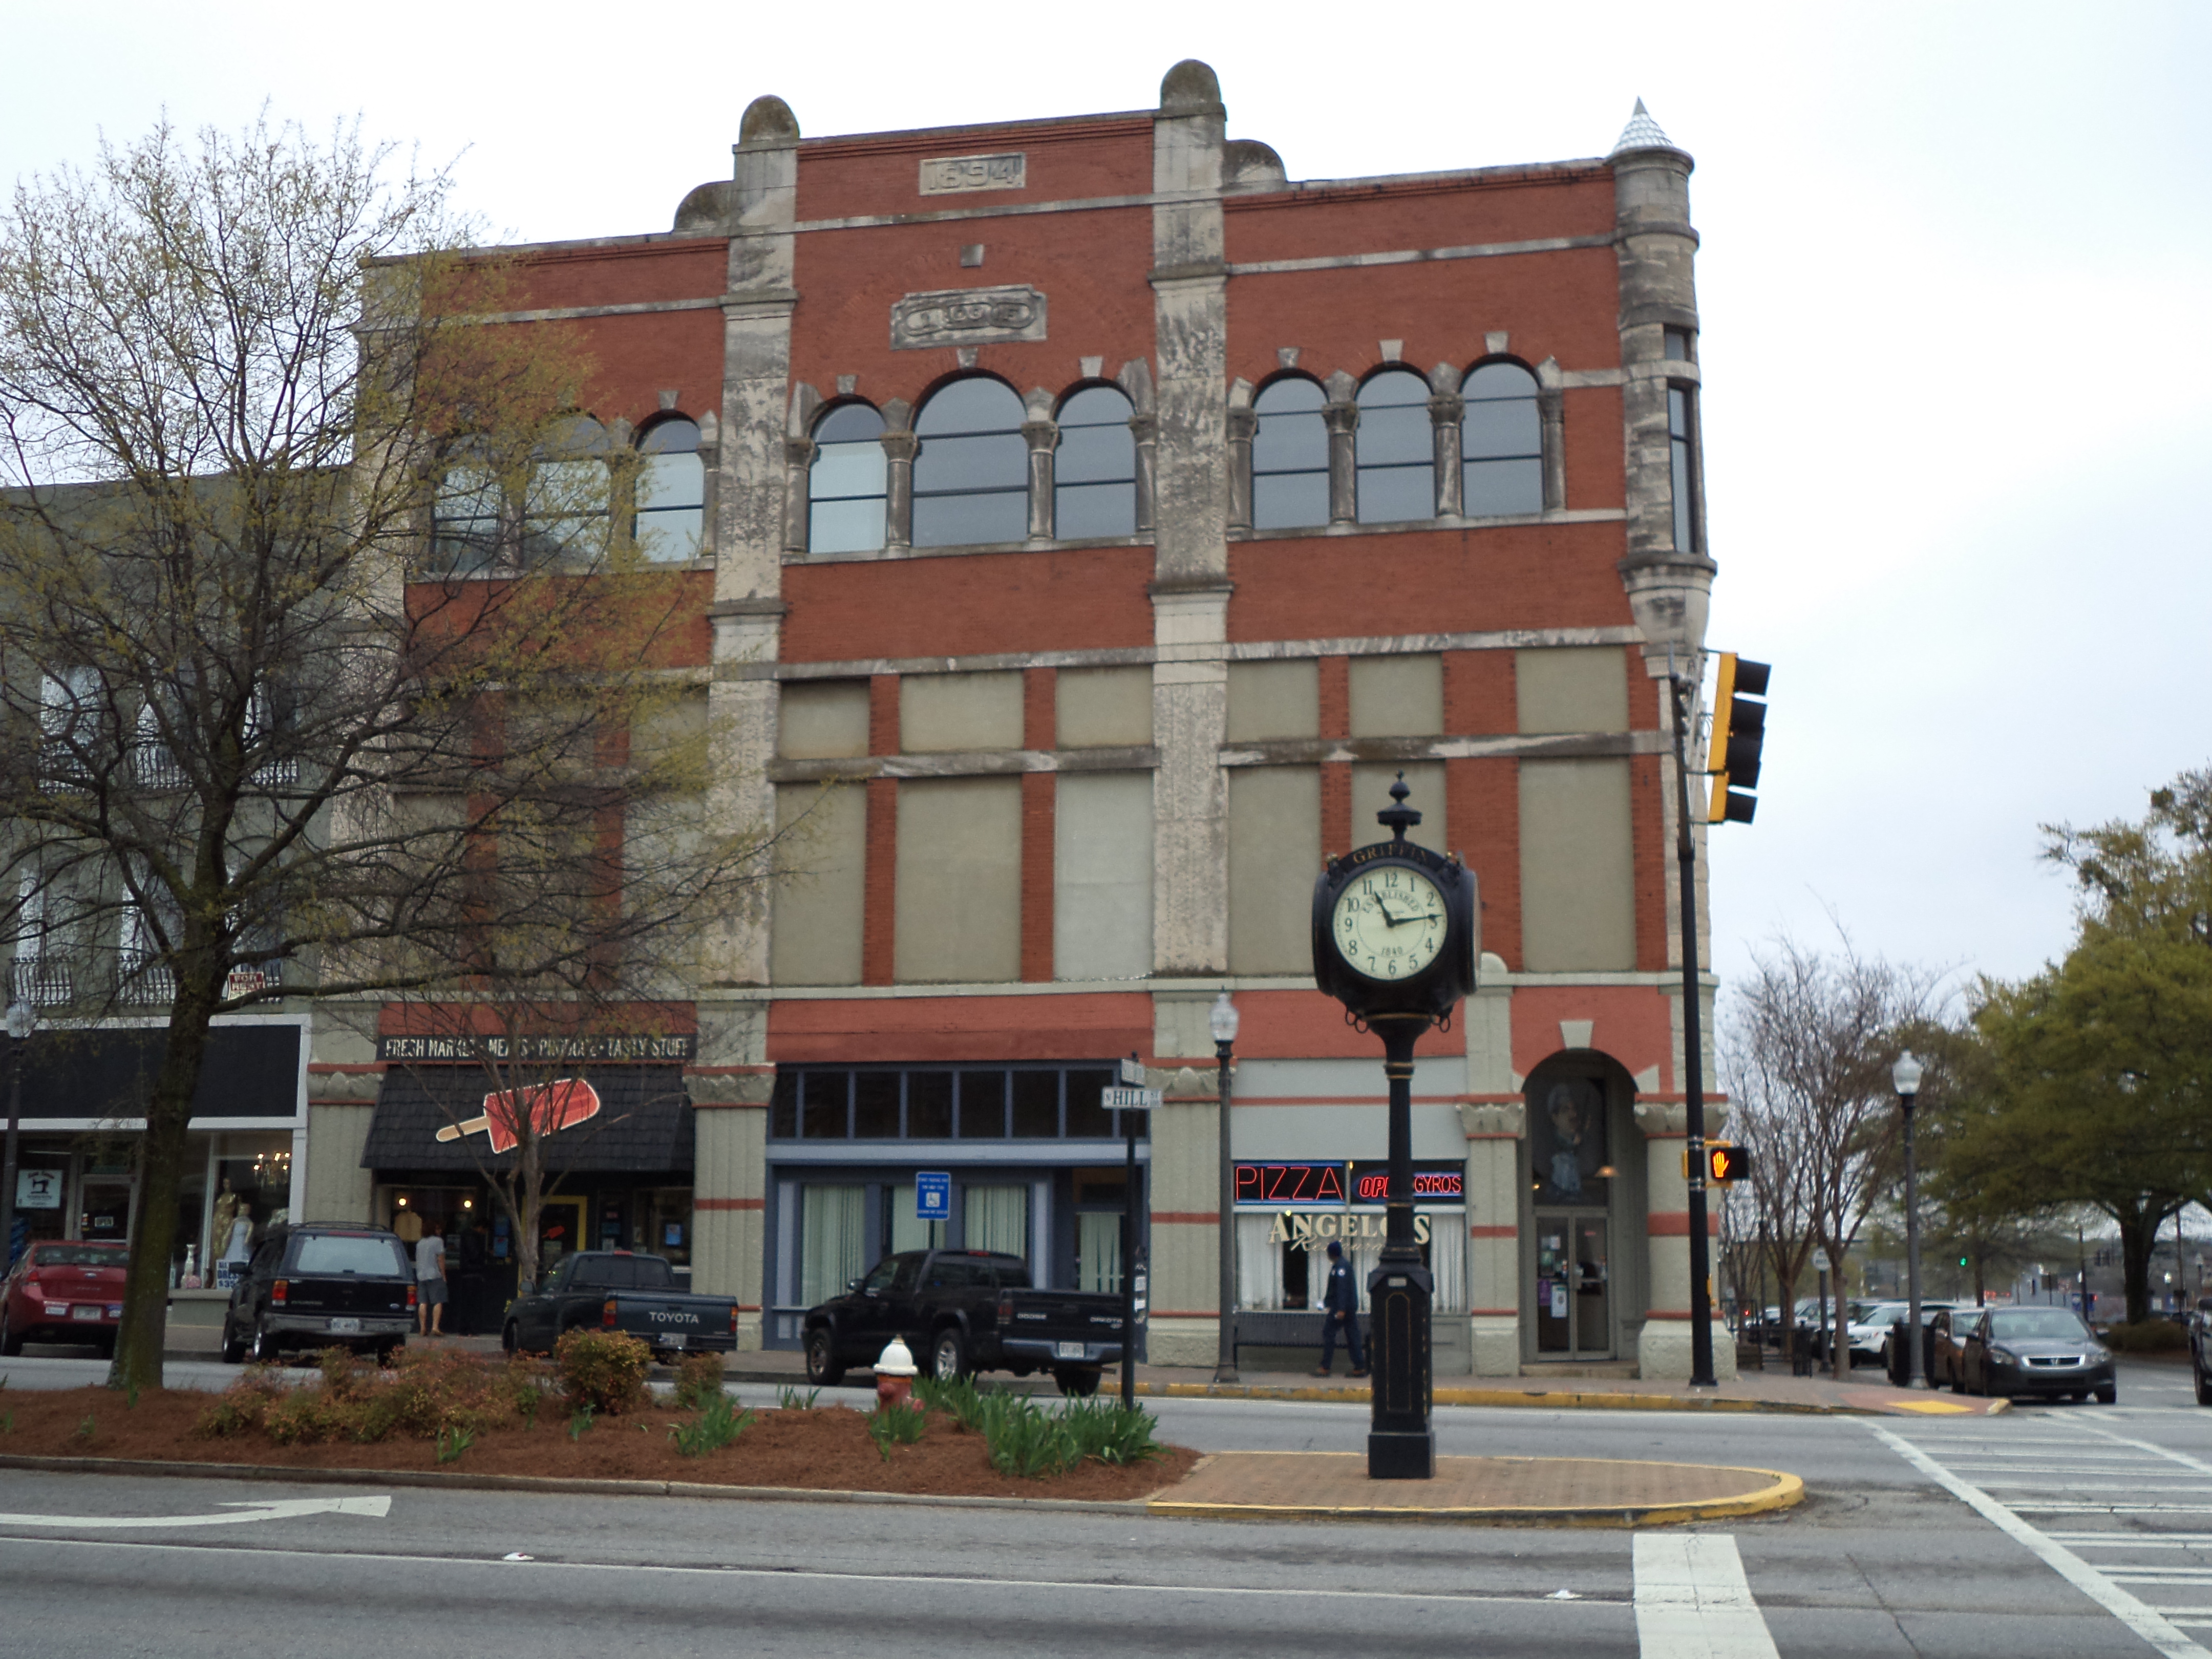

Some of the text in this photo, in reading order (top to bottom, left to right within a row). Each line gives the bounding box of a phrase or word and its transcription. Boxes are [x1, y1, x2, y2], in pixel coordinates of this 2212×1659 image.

[928, 160, 1014, 190] 1894
[1386, 870, 1398, 887] 12
[1410, 877, 1415, 892] 1
[1363, 879, 1373, 895] 11
[1346, 897, 1360, 912] 10
[1362, 890, 1421, 913] ESTBLISHED
[1427, 892, 1435, 907] 2
[1344, 917, 1353, 932] 9
[1348, 940, 1357, 955] 8
[1426, 938, 1434, 953] 4
[1368, 956, 1375, 972] 7
[1388, 959, 1397, 974] 6
[1409, 953, 1418, 969] 5
[386, 1039, 424, 1057] FRESH
[488, 1038, 528, 1057] MES
[608, 1038, 647, 1057] TASTY
[652, 1038, 689, 1057] STUFF
[1113, 1091, 1147, 1105] HILL
[1236, 1166, 1344, 1200] PIZZA
[1359, 1176, 1389, 1198] OPE
[1414, 1176, 1462, 1193] GYROS
[1269, 1211, 1431, 1245] ANGELS
[649, 1311, 699, 1324] TOYOTA
